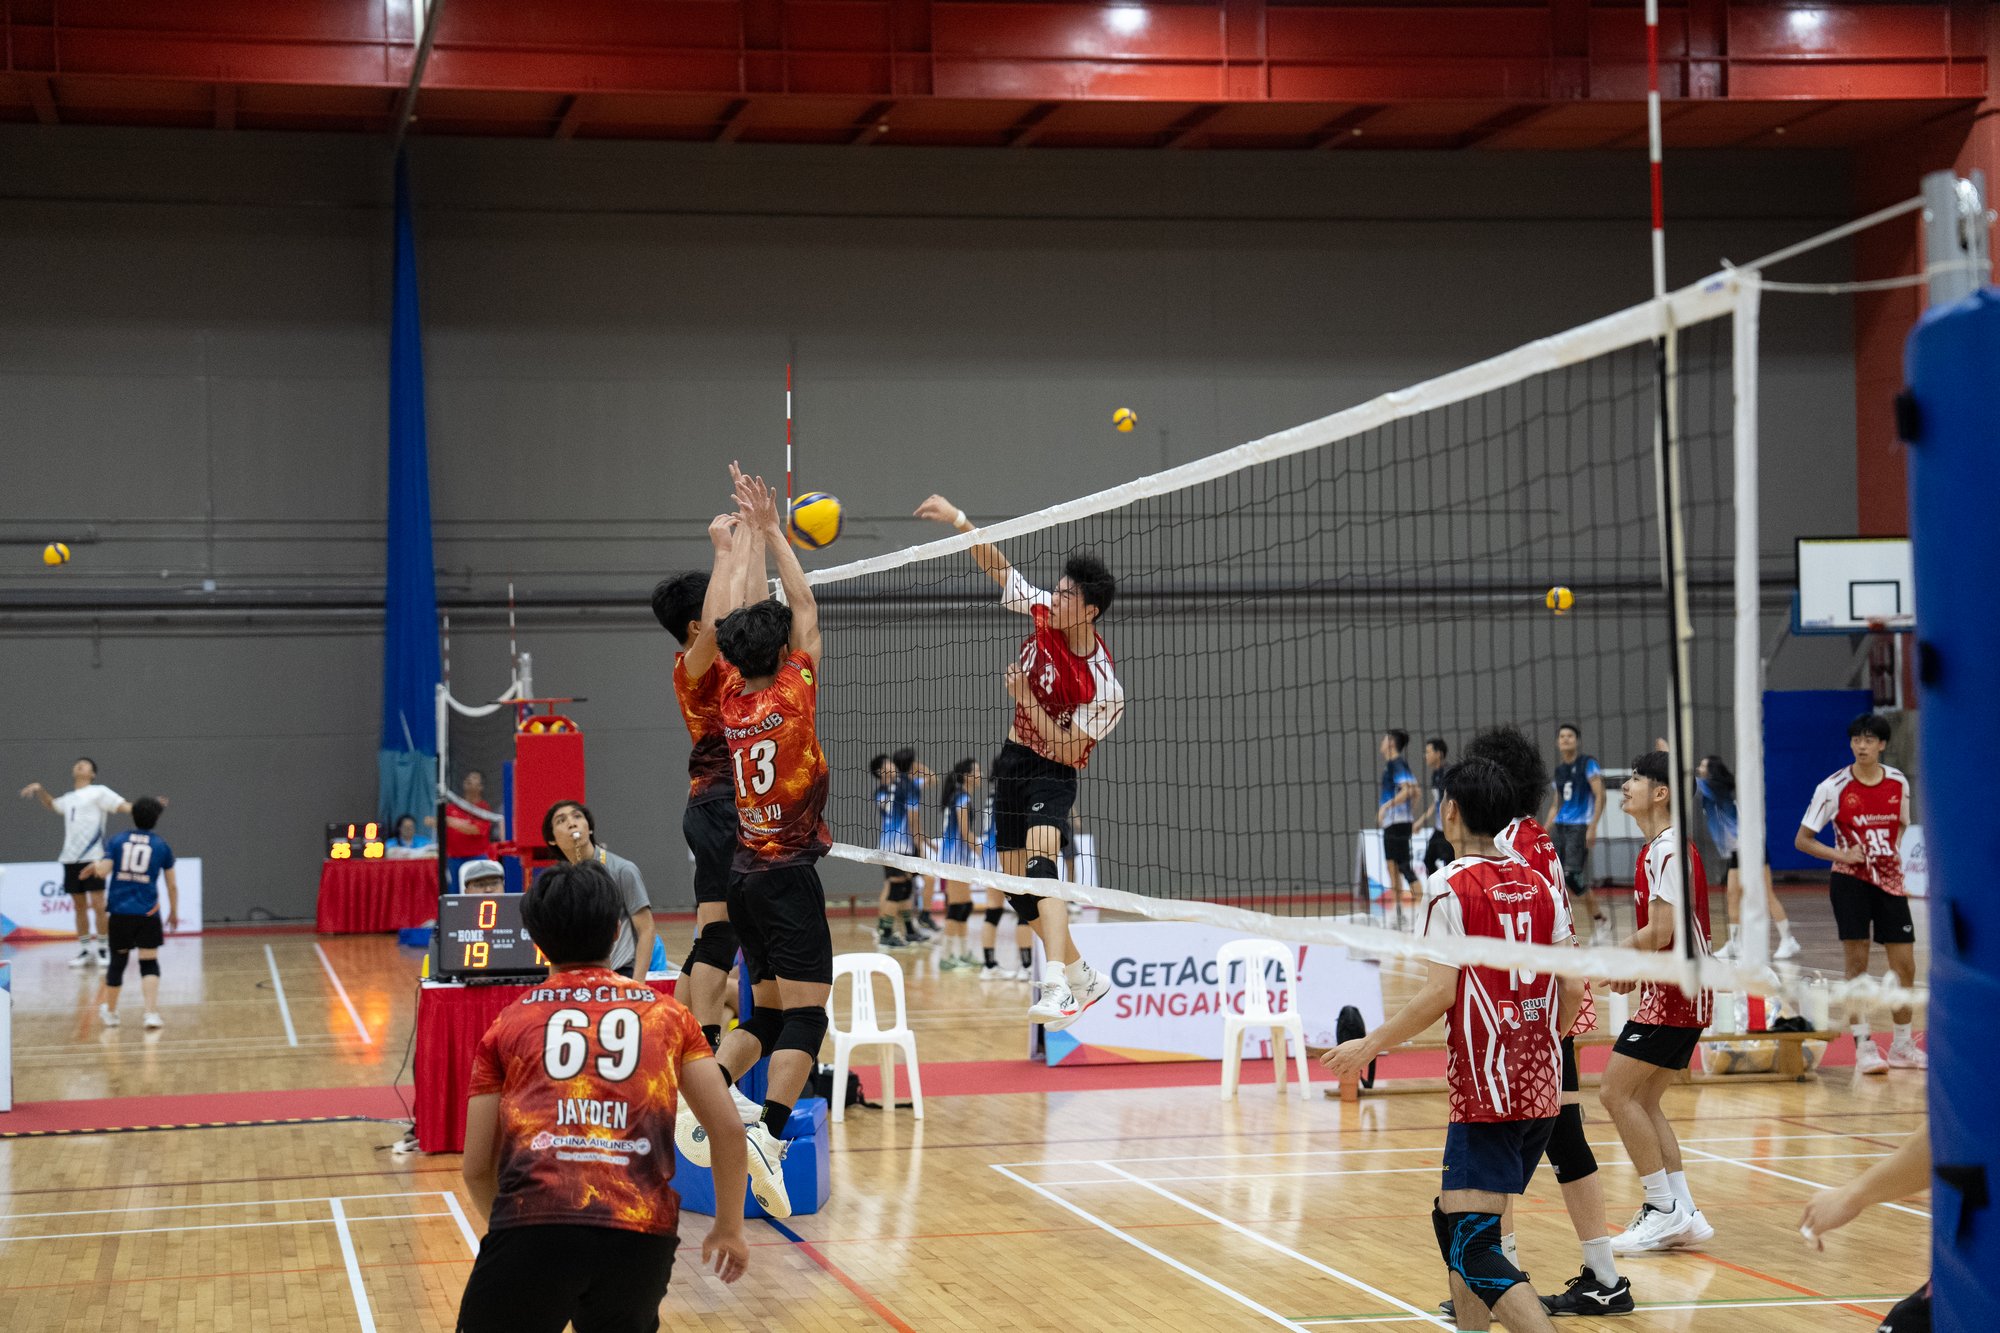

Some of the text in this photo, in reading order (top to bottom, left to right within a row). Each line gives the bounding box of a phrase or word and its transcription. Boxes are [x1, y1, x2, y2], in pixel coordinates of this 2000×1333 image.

[747, 712, 783, 737] CLUB
[734, 739, 778, 798] 13
[764, 803, 782, 822] YU
[364, 822, 378, 840] 0
[1865, 828, 1894, 857] 35
[121, 842, 152, 873] 10
[479, 900, 497, 929] 0
[463, 942, 490, 968] 19
[595, 985, 657, 1003] CLUB
[544, 1007, 642, 1082] 69
[556, 1098, 628, 1129] JAYDEN
[552, 1137, 634, 1150] CHINA AIRLINES
